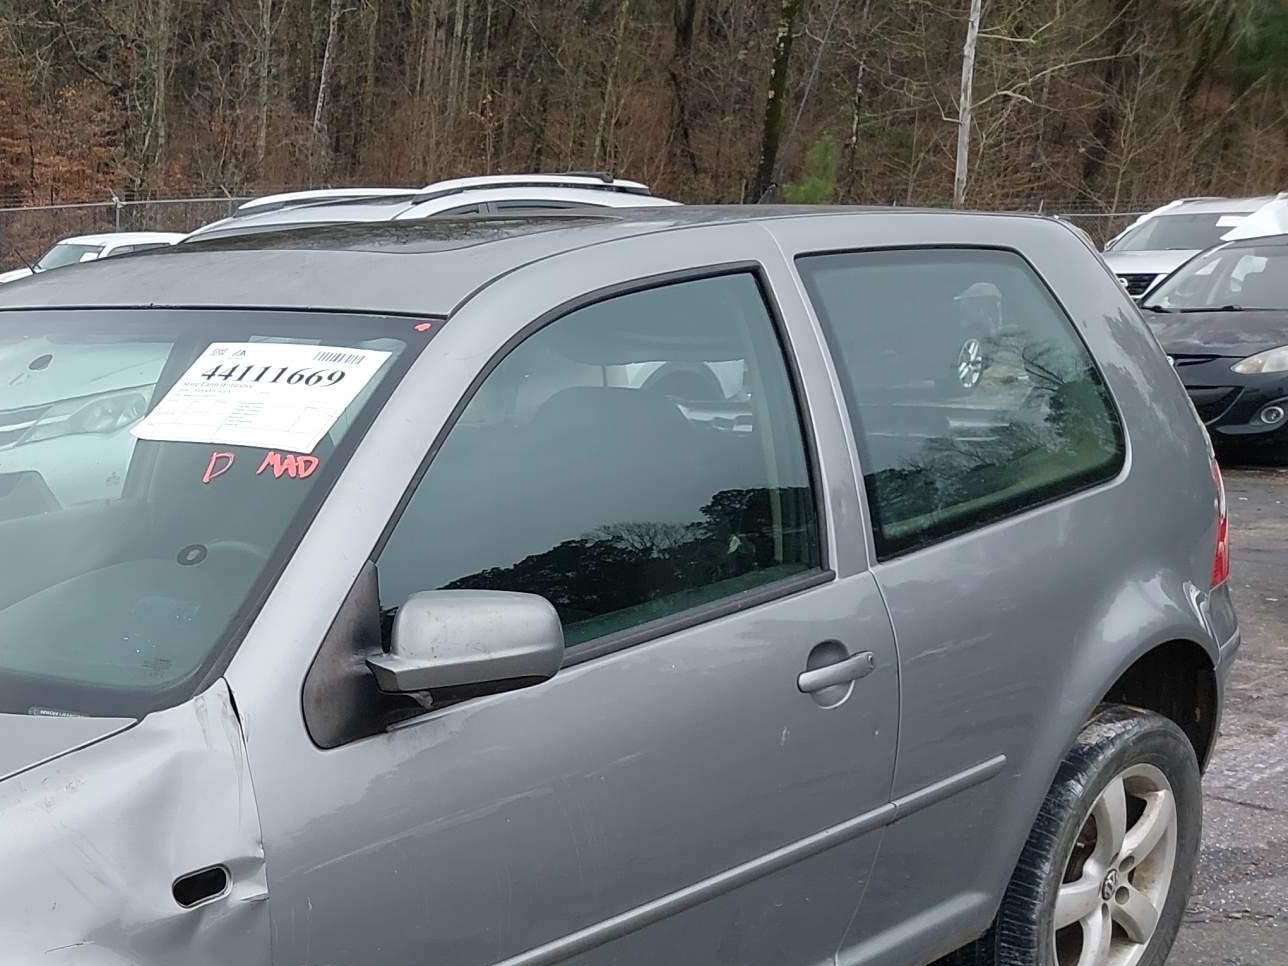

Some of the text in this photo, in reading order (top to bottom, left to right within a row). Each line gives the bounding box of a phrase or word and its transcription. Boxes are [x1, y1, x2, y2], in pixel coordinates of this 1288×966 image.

[201, 363, 346, 388] 44111669
[202, 451, 319, 483] D MAD
